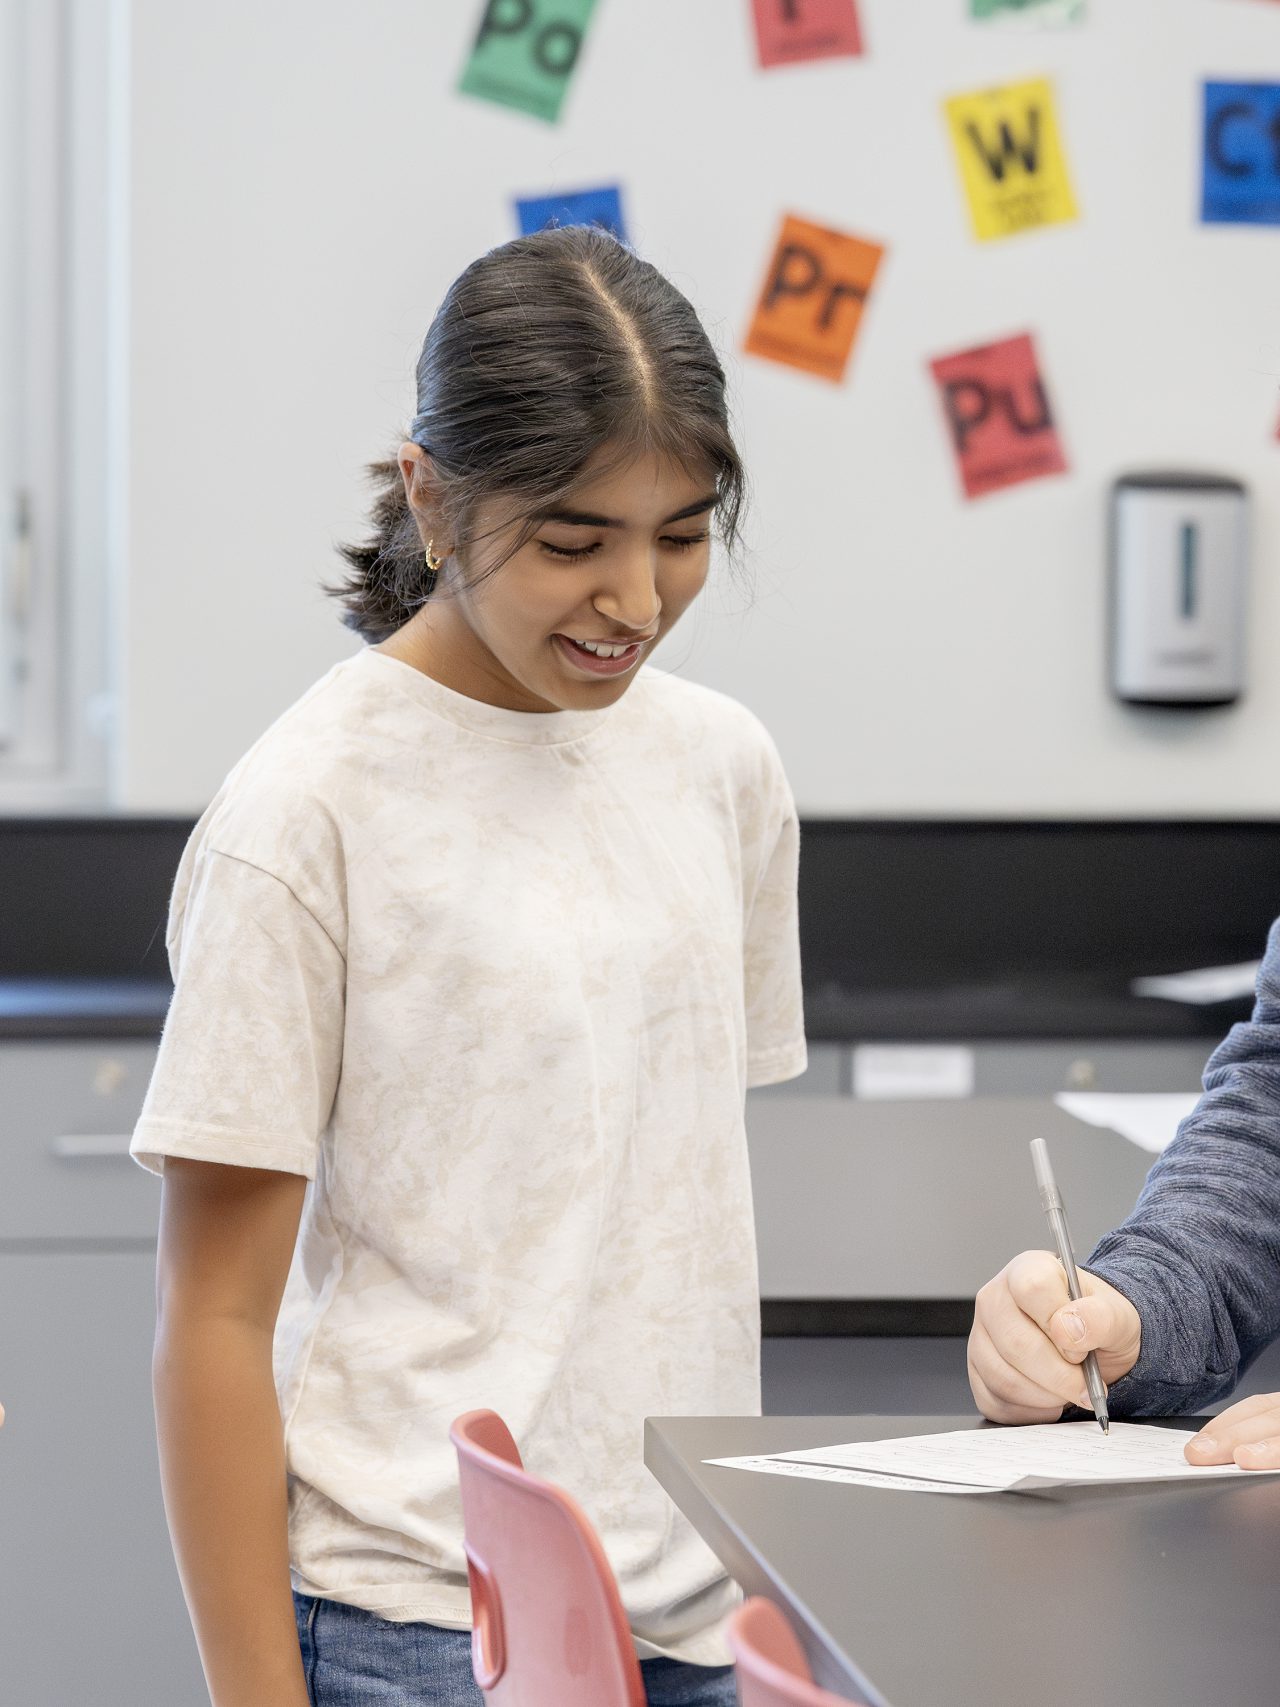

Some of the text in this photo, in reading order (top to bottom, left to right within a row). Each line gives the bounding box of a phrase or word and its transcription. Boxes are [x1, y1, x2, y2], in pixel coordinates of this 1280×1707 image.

[964, 106, 1040, 182] W
[763, 244, 866, 330] Pr
[944, 376, 1053, 453] Pu
